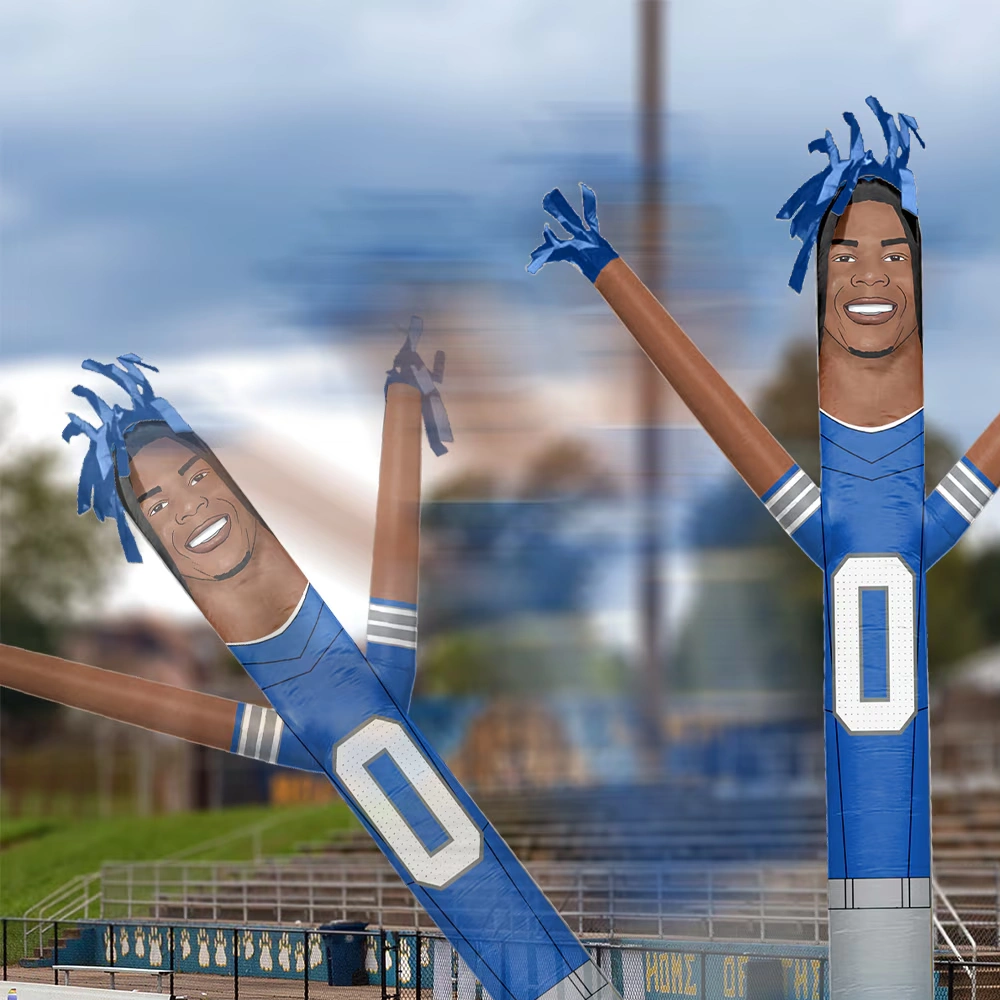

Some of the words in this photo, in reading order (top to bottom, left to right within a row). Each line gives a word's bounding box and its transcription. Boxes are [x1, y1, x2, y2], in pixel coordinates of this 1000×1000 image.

[831, 553, 918, 735] 0
[332, 714, 484, 891] 0
[723, 955, 749, 998] OF
